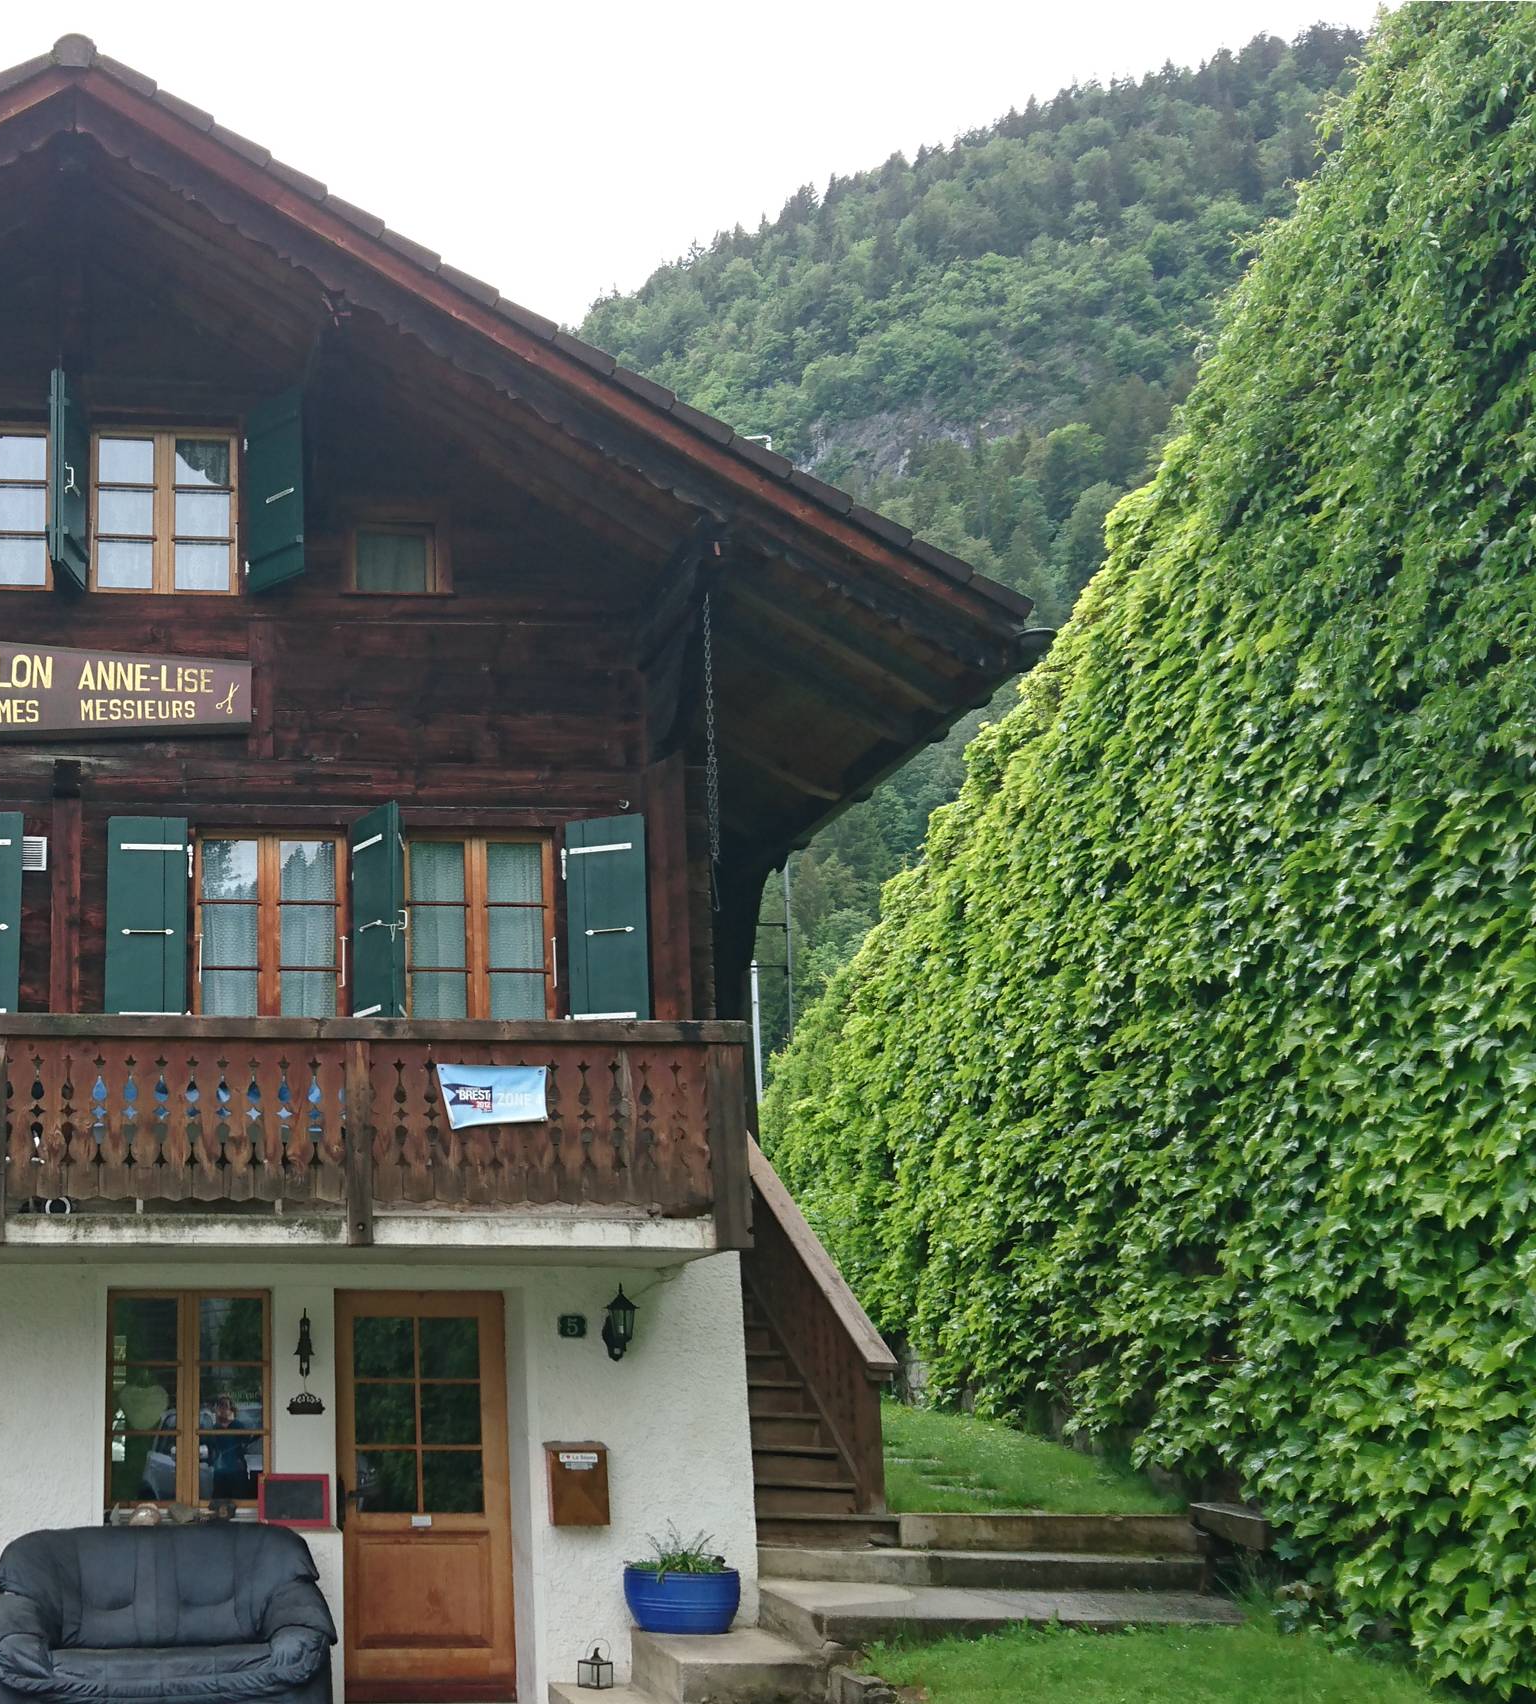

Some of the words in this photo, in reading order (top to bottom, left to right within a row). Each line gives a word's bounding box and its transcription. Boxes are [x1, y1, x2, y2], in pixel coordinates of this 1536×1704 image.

[77, 660, 214, 694] ANNE-LISE
[80, 699, 196, 721] MESSIEURS
[495, 1092, 532, 1105] ZONE
[567, 1318, 579, 1336] 5
